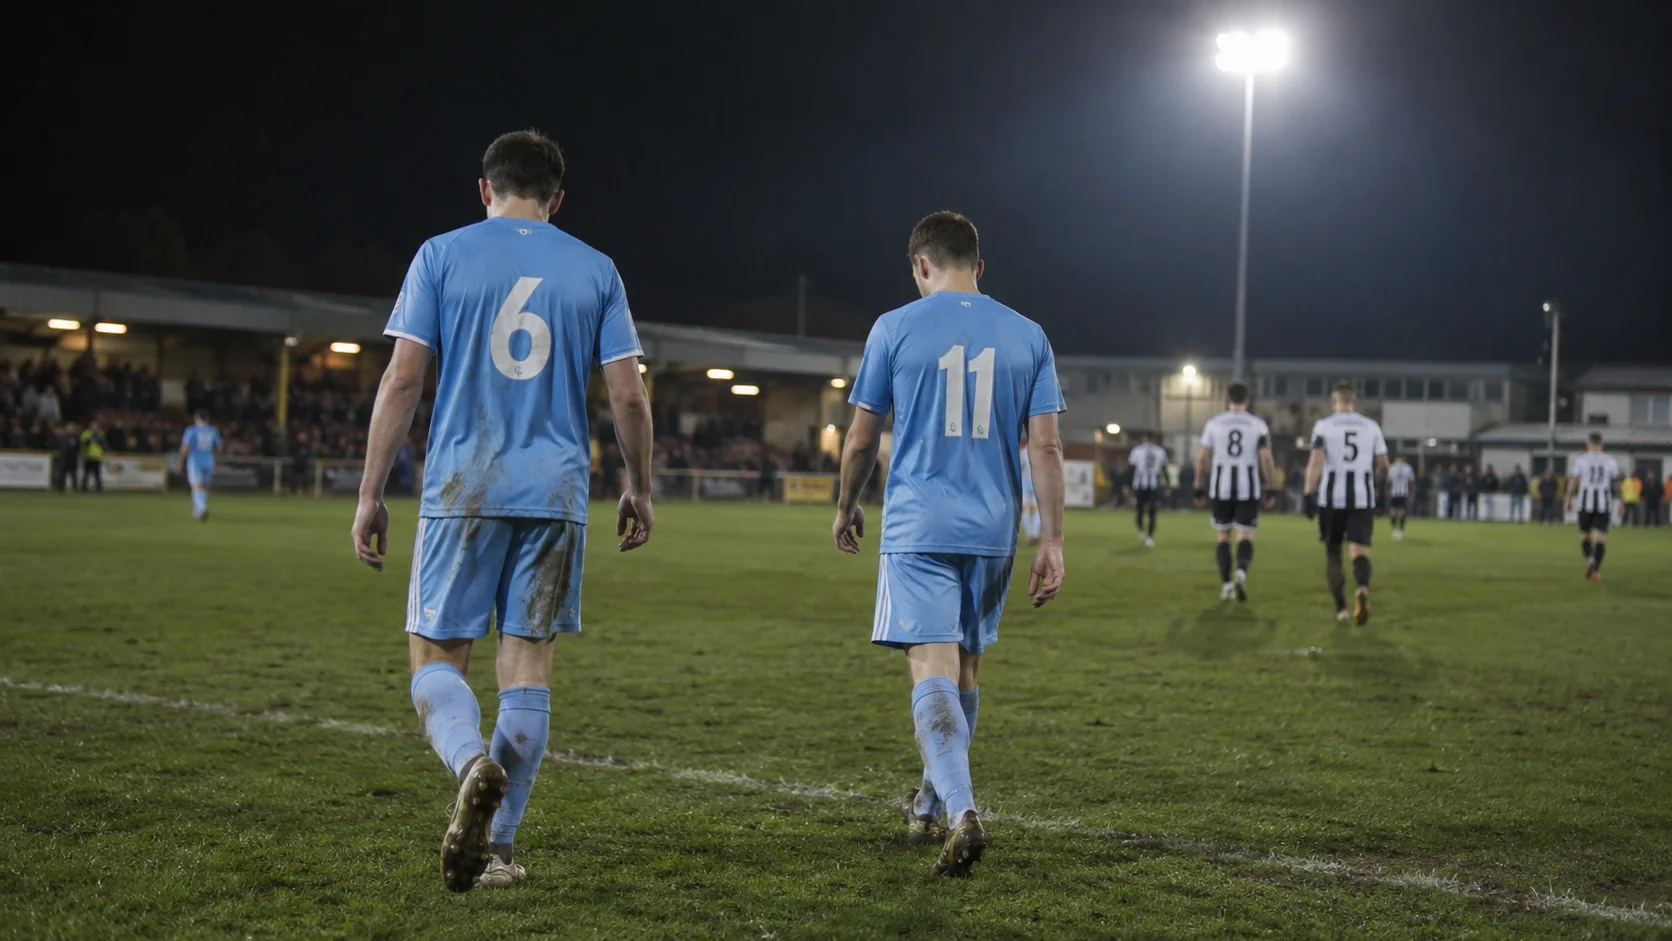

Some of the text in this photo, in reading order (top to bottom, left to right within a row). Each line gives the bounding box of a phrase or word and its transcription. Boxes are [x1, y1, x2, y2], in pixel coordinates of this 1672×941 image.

[490, 276, 552, 380] 6
[938, 344, 996, 439] 11
[1227, 429, 1243, 458] 8
[1343, 431, 1358, 462] 5
